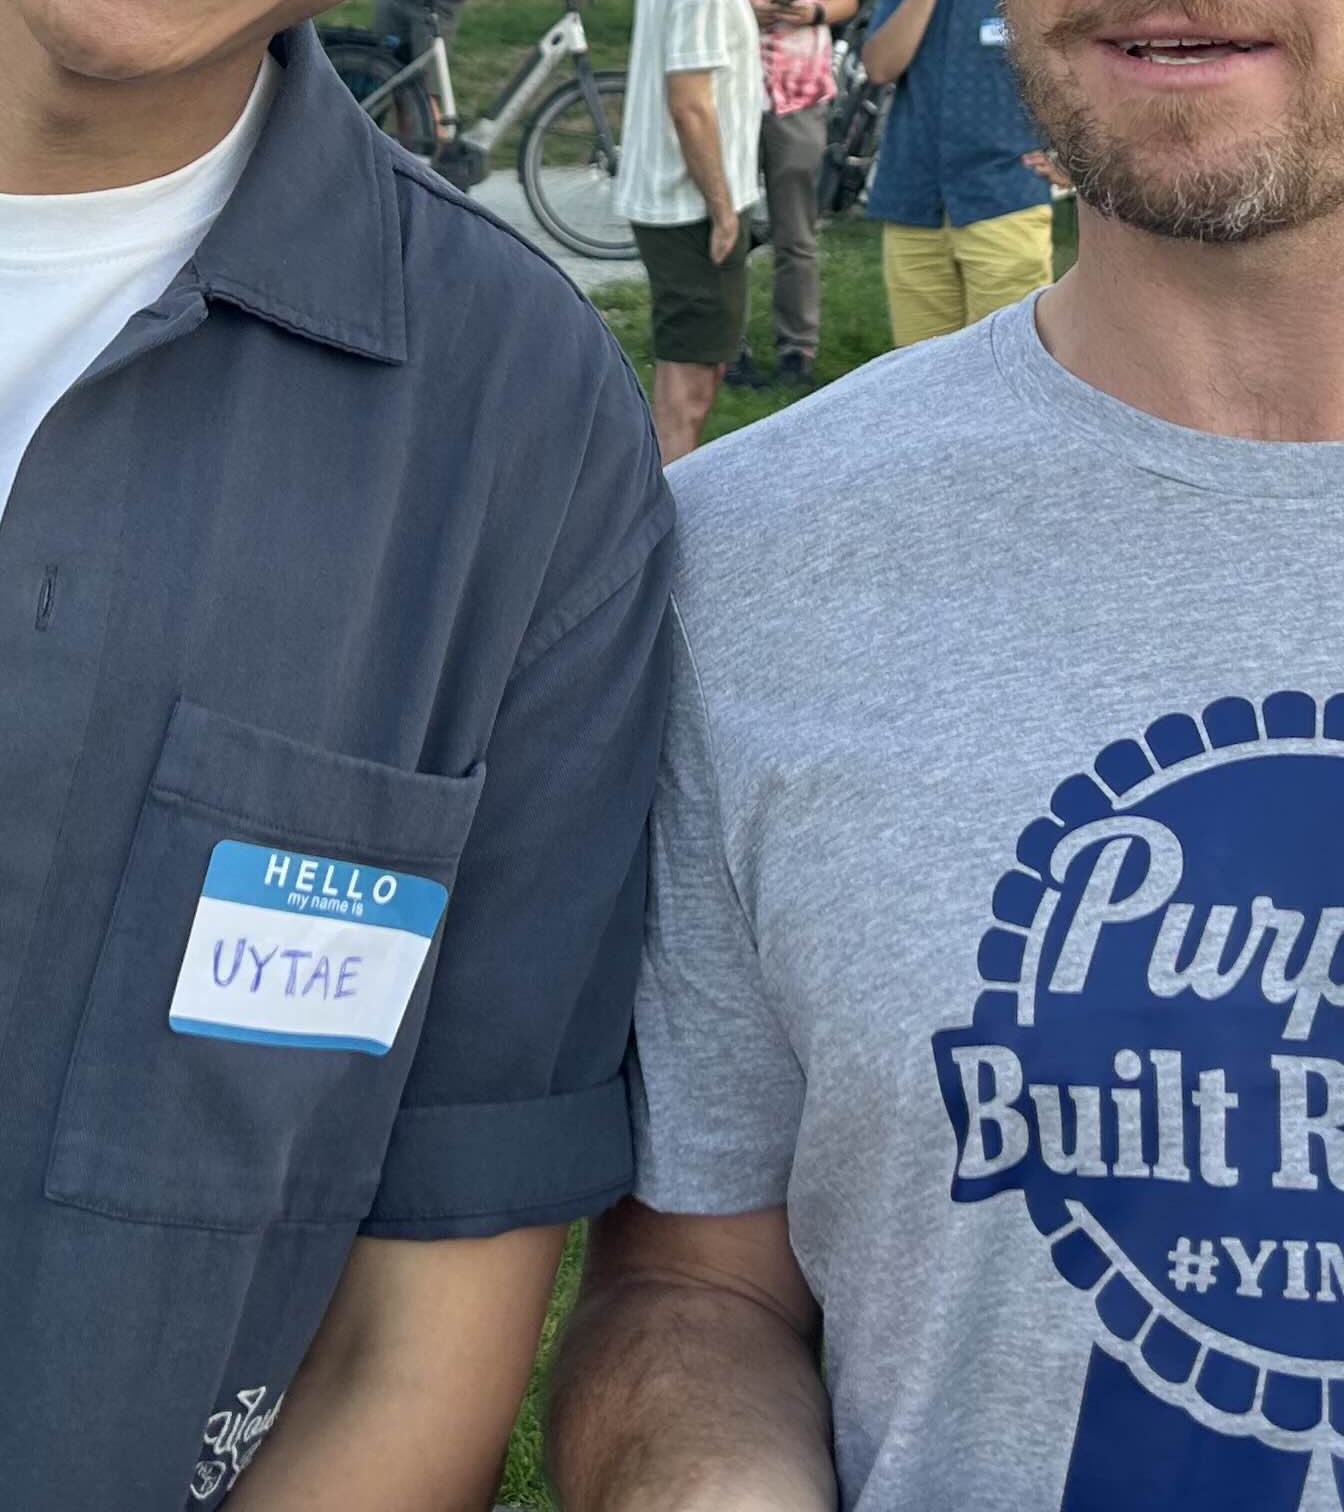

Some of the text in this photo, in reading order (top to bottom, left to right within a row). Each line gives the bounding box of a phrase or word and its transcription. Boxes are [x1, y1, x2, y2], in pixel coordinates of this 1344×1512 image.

[263, 853, 398, 905] HELLO
[287, 891, 364, 917] my name is
[212, 937, 362, 1000] UYTAE
[951, 1044, 1240, 1188] Built
